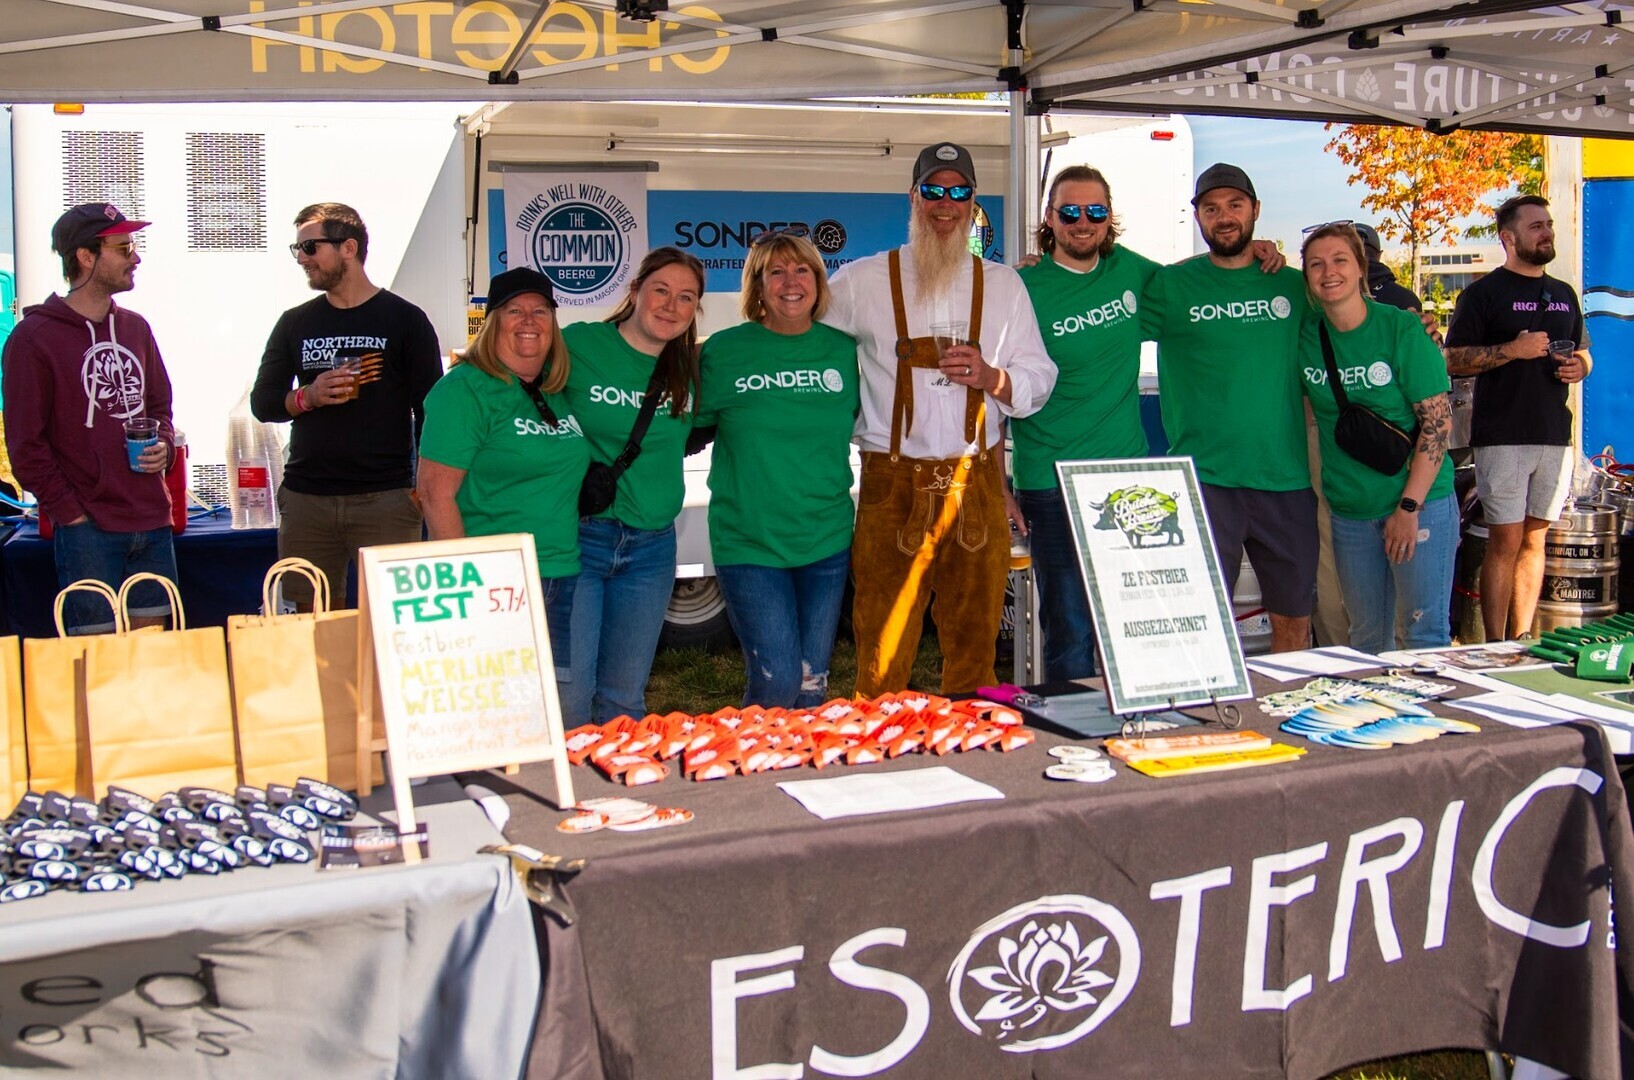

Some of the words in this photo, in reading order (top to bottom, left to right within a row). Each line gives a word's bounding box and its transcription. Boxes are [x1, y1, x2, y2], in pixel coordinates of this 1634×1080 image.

[516, 194, 550, 232] DRINKS
[547, 183, 576, 204] WELL
[579, 183, 607, 205] WITH
[604, 195, 637, 233] OTHERS
[569, 212, 585, 228] THE
[539, 234, 616, 262] COMMON
[555, 294, 586, 306] SERVED
[594, 281, 620, 303] MASON
[617, 263, 630, 283] OHIO
[1052, 299, 1131, 336] SONDER
[1189, 300, 1278, 323] SONDER
[302, 336, 388, 350] NORTHERN
[302, 349, 338, 363] ROW
[735, 369, 830, 393] SONDER
[387, 561, 484, 594] BOBA
[1122, 571, 1137, 588] ZE
[1560, 589, 1596, 599] MADTREE
[392, 591, 474, 625] FEST
[392, 628, 477, 655] Festbier
[401, 647, 538, 689] MERLINER
[401, 681, 508, 716] WEISSE
